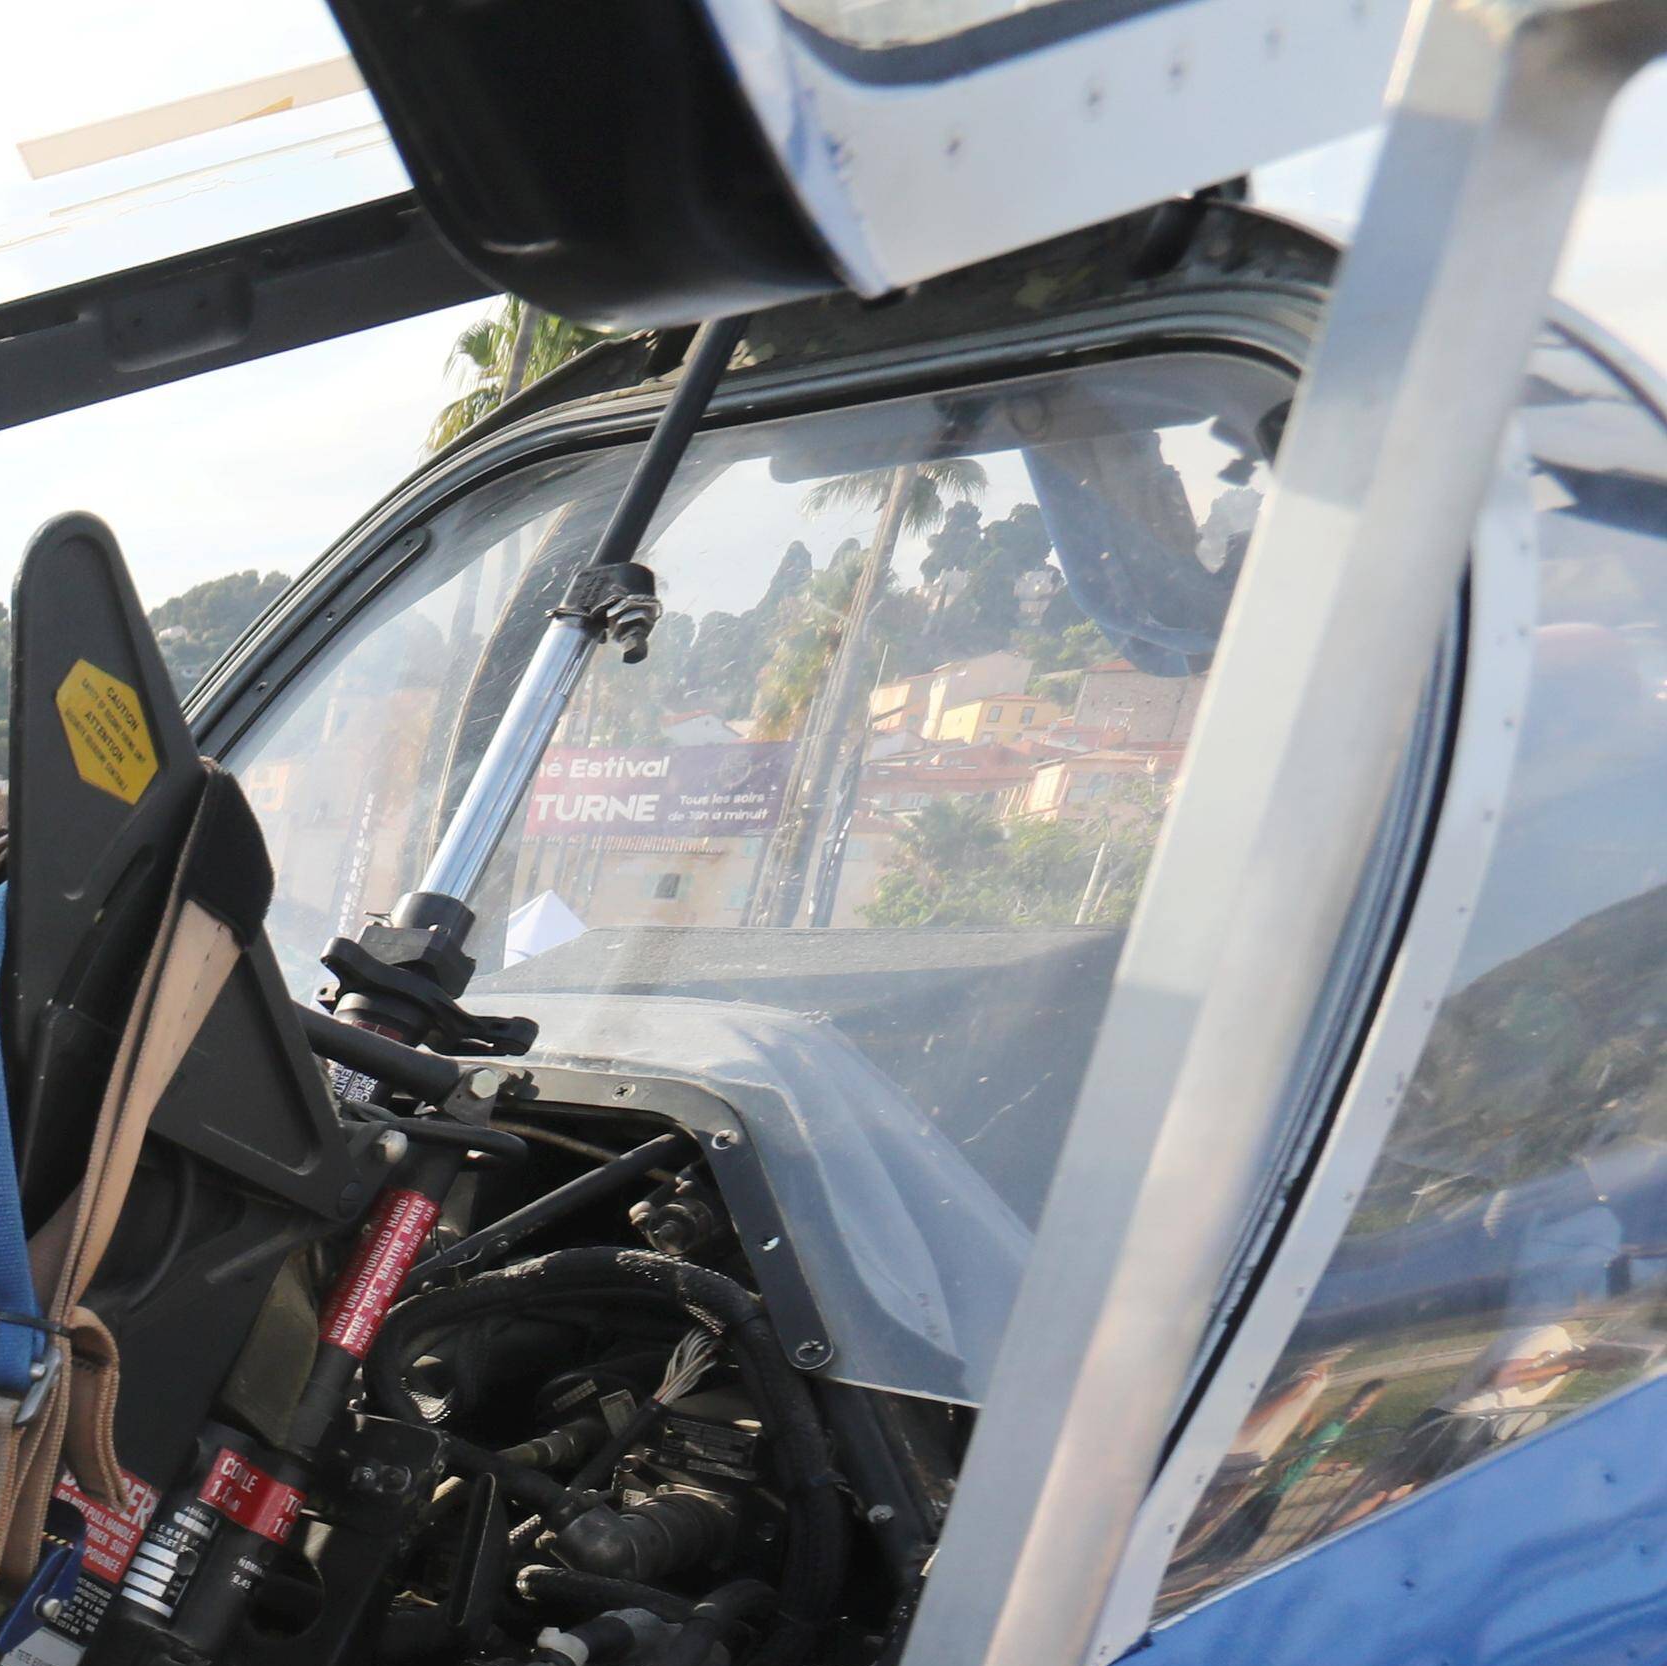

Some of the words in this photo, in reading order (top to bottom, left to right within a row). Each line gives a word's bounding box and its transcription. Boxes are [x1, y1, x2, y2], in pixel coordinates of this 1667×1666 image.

[106, 687, 139, 732] CAUTION
[84, 711, 126, 763] ATTENTION
[569, 756, 670, 778] Estival
[532, 794, 660, 822] TURNE
[680, 794, 708, 806] Tous
[723, 807, 769, 821] minuit
[329, 1312, 351, 1340] WITH
[346, 1231, 393, 1310] UNAUTHORIZED
[343, 1314, 367, 1345] WARE
[365, 1284, 381, 1308] USE
[381, 1240, 405, 1281] MARTIN
[403, 1199, 427, 1235] BAKER
[356, 1324, 375, 1350] PART
[84, 1505, 109, 1527] PULL
[103, 1516, 138, 1543] HANDLE
[82, 1544, 122, 1574] POIGNEE
[108, 1537, 130, 1557] SUR
